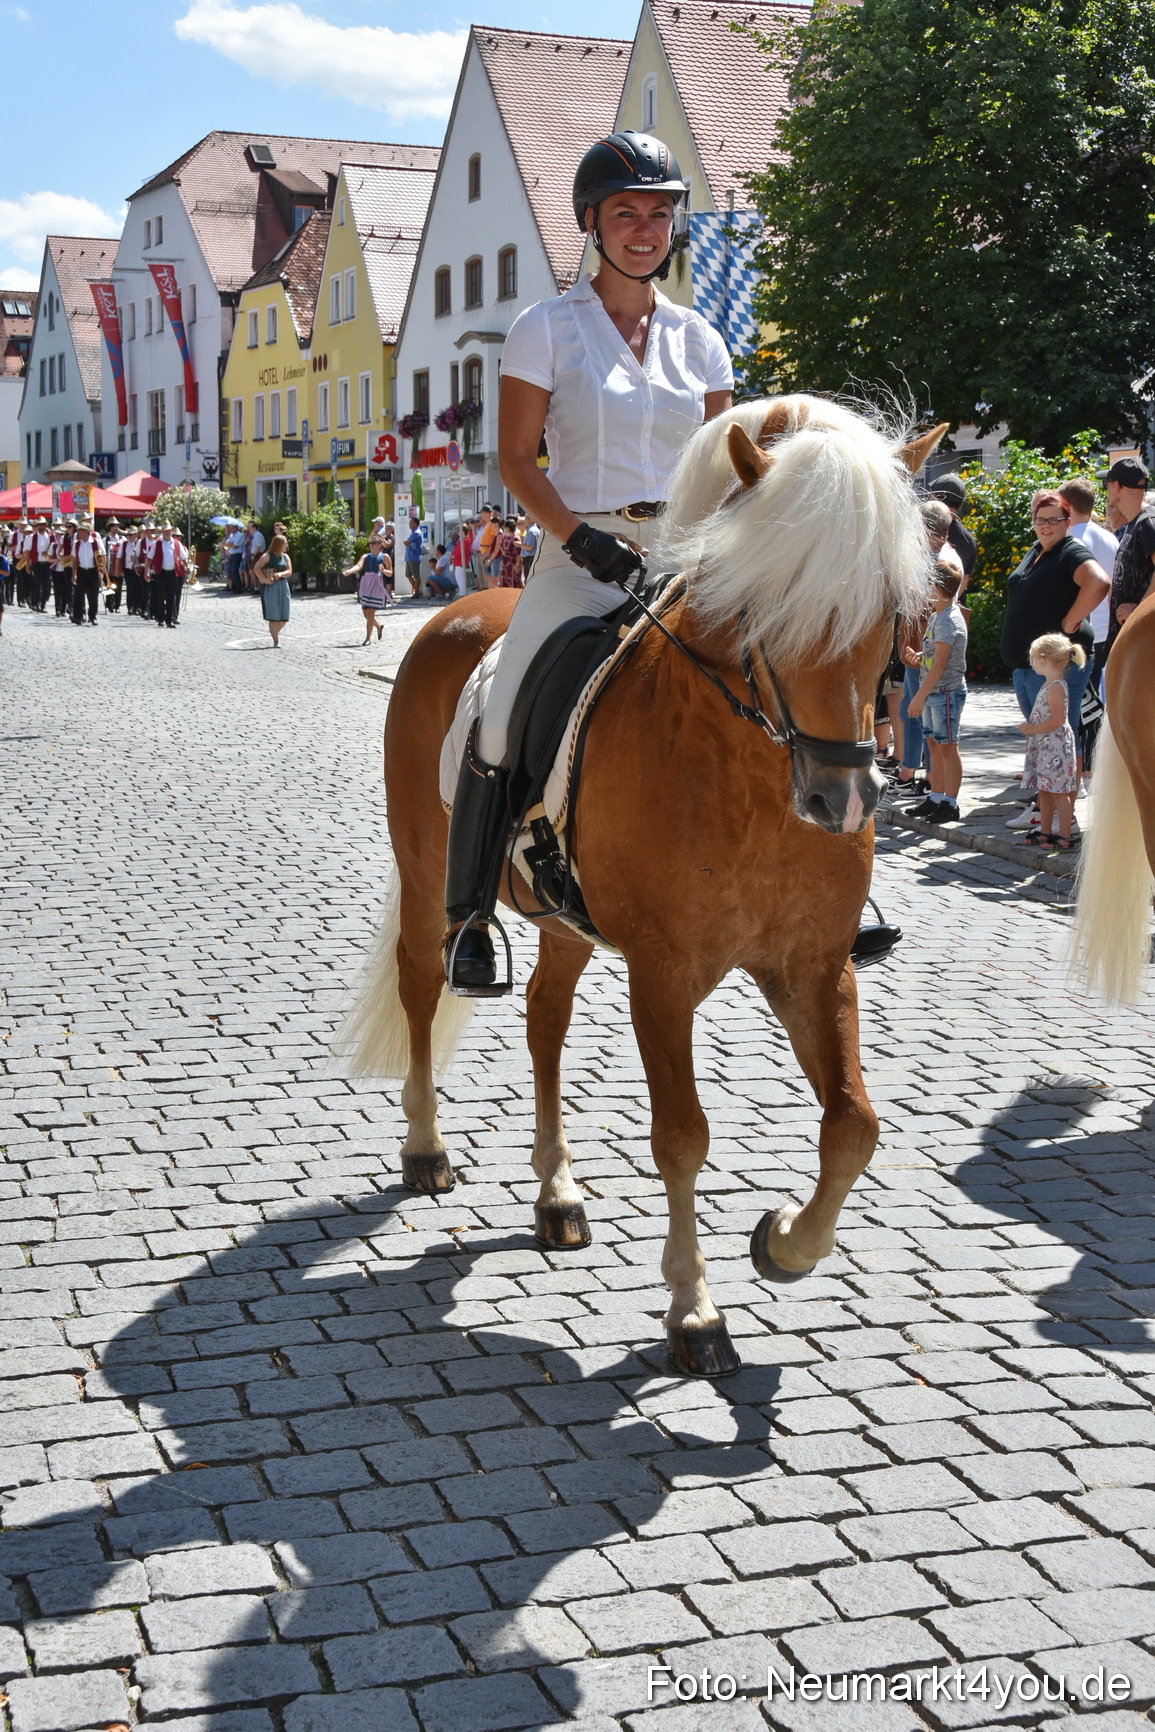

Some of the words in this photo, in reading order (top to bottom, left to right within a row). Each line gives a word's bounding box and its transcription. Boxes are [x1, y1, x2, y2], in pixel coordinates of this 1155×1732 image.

[258, 367, 278, 387] HOTEL
[283, 364, 306, 381] Lehmeier
[258, 459, 285, 473] Restaurant
